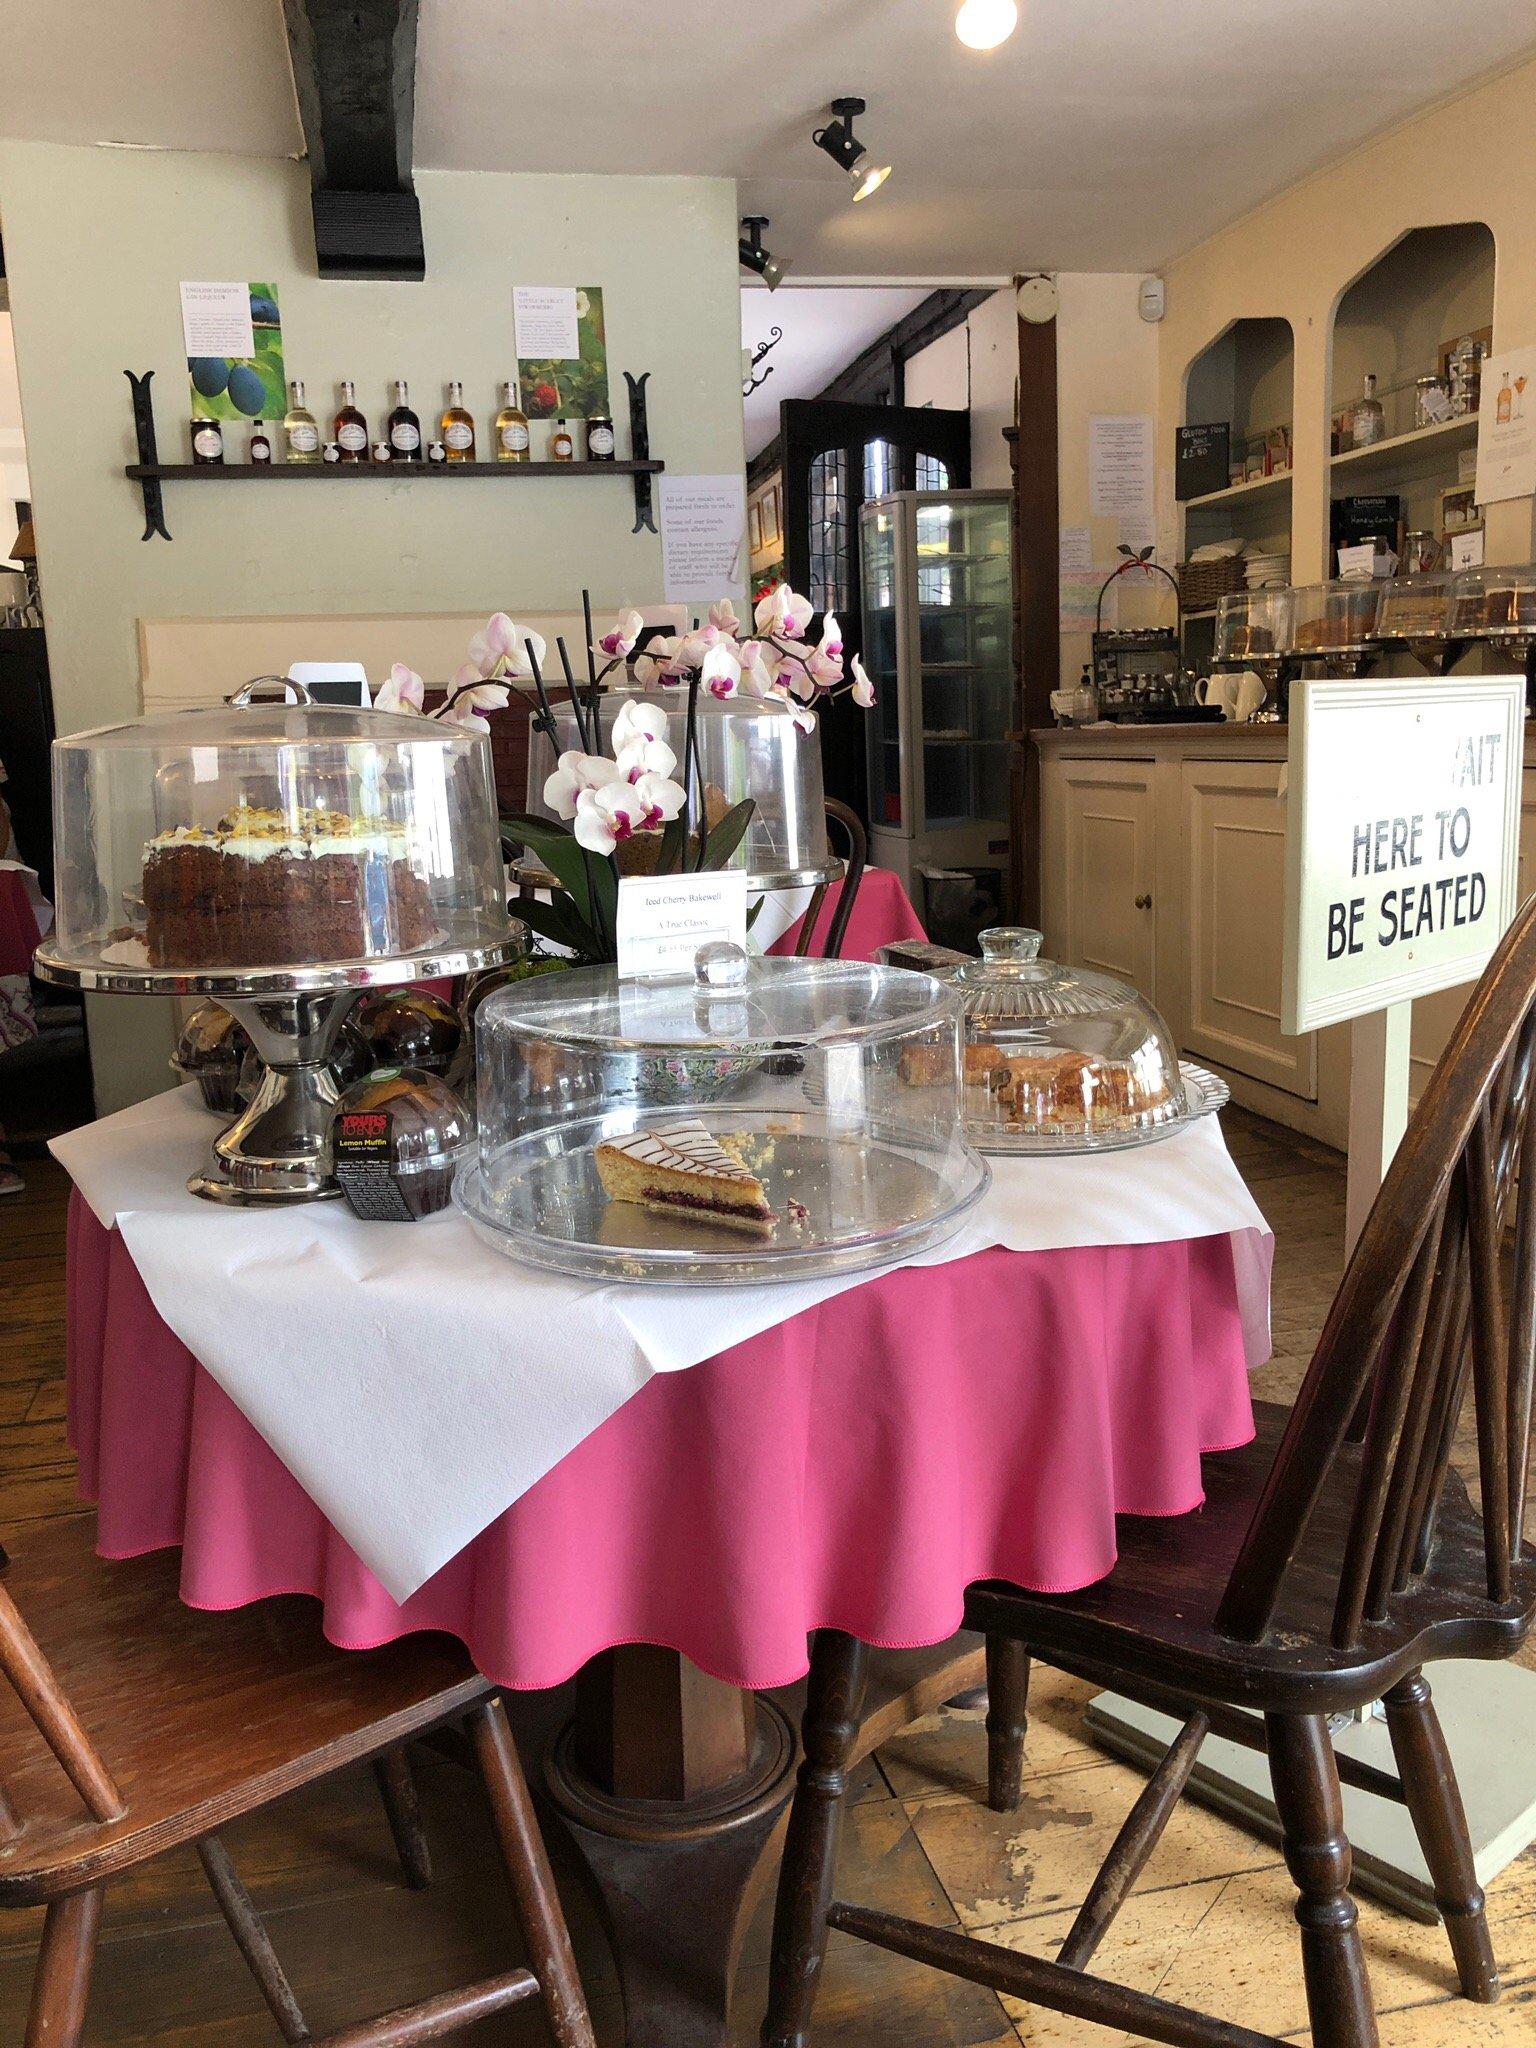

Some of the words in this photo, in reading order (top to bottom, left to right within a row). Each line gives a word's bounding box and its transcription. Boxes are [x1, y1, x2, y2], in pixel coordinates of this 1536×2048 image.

[1351, 814, 1423, 878] HERE
[1435, 806, 1471, 861] TO
[662, 895, 687, 905] Cherry
[688, 891, 722, 903] Bakewell
[1327, 897, 1365, 961] BE
[1378, 872, 1486, 947] SEATED
[342, 1114, 387, 1127] YOURS
